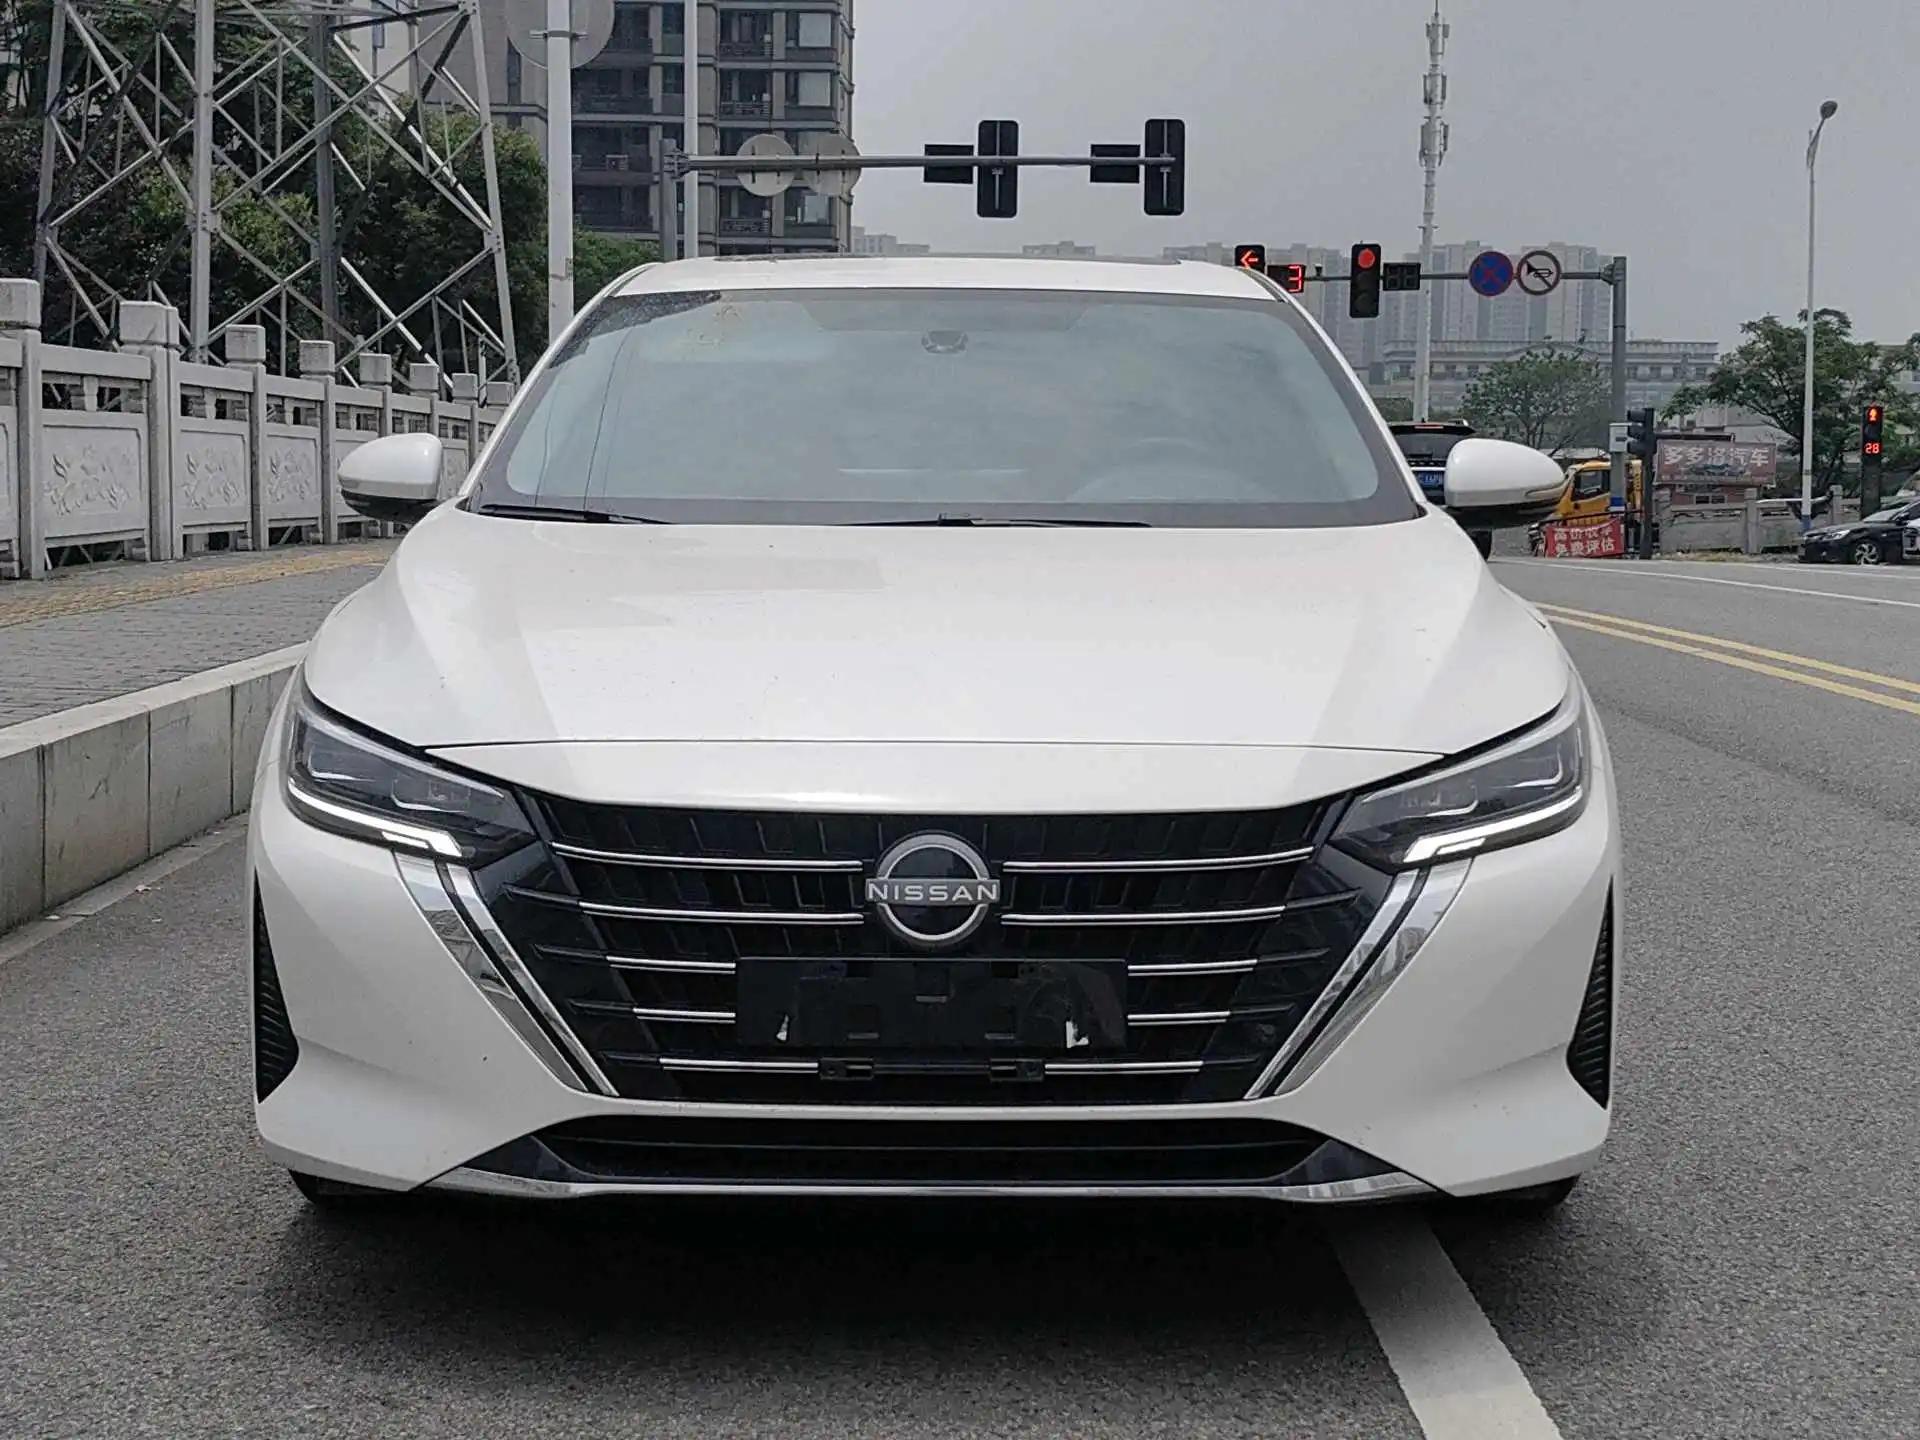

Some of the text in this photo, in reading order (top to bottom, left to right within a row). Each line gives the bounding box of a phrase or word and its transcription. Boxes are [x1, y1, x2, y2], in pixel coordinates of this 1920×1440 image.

[1288, 264, 1302, 293] 3
[1864, 442, 1880, 454] 28
[867, 883, 998, 902] NISSAN
